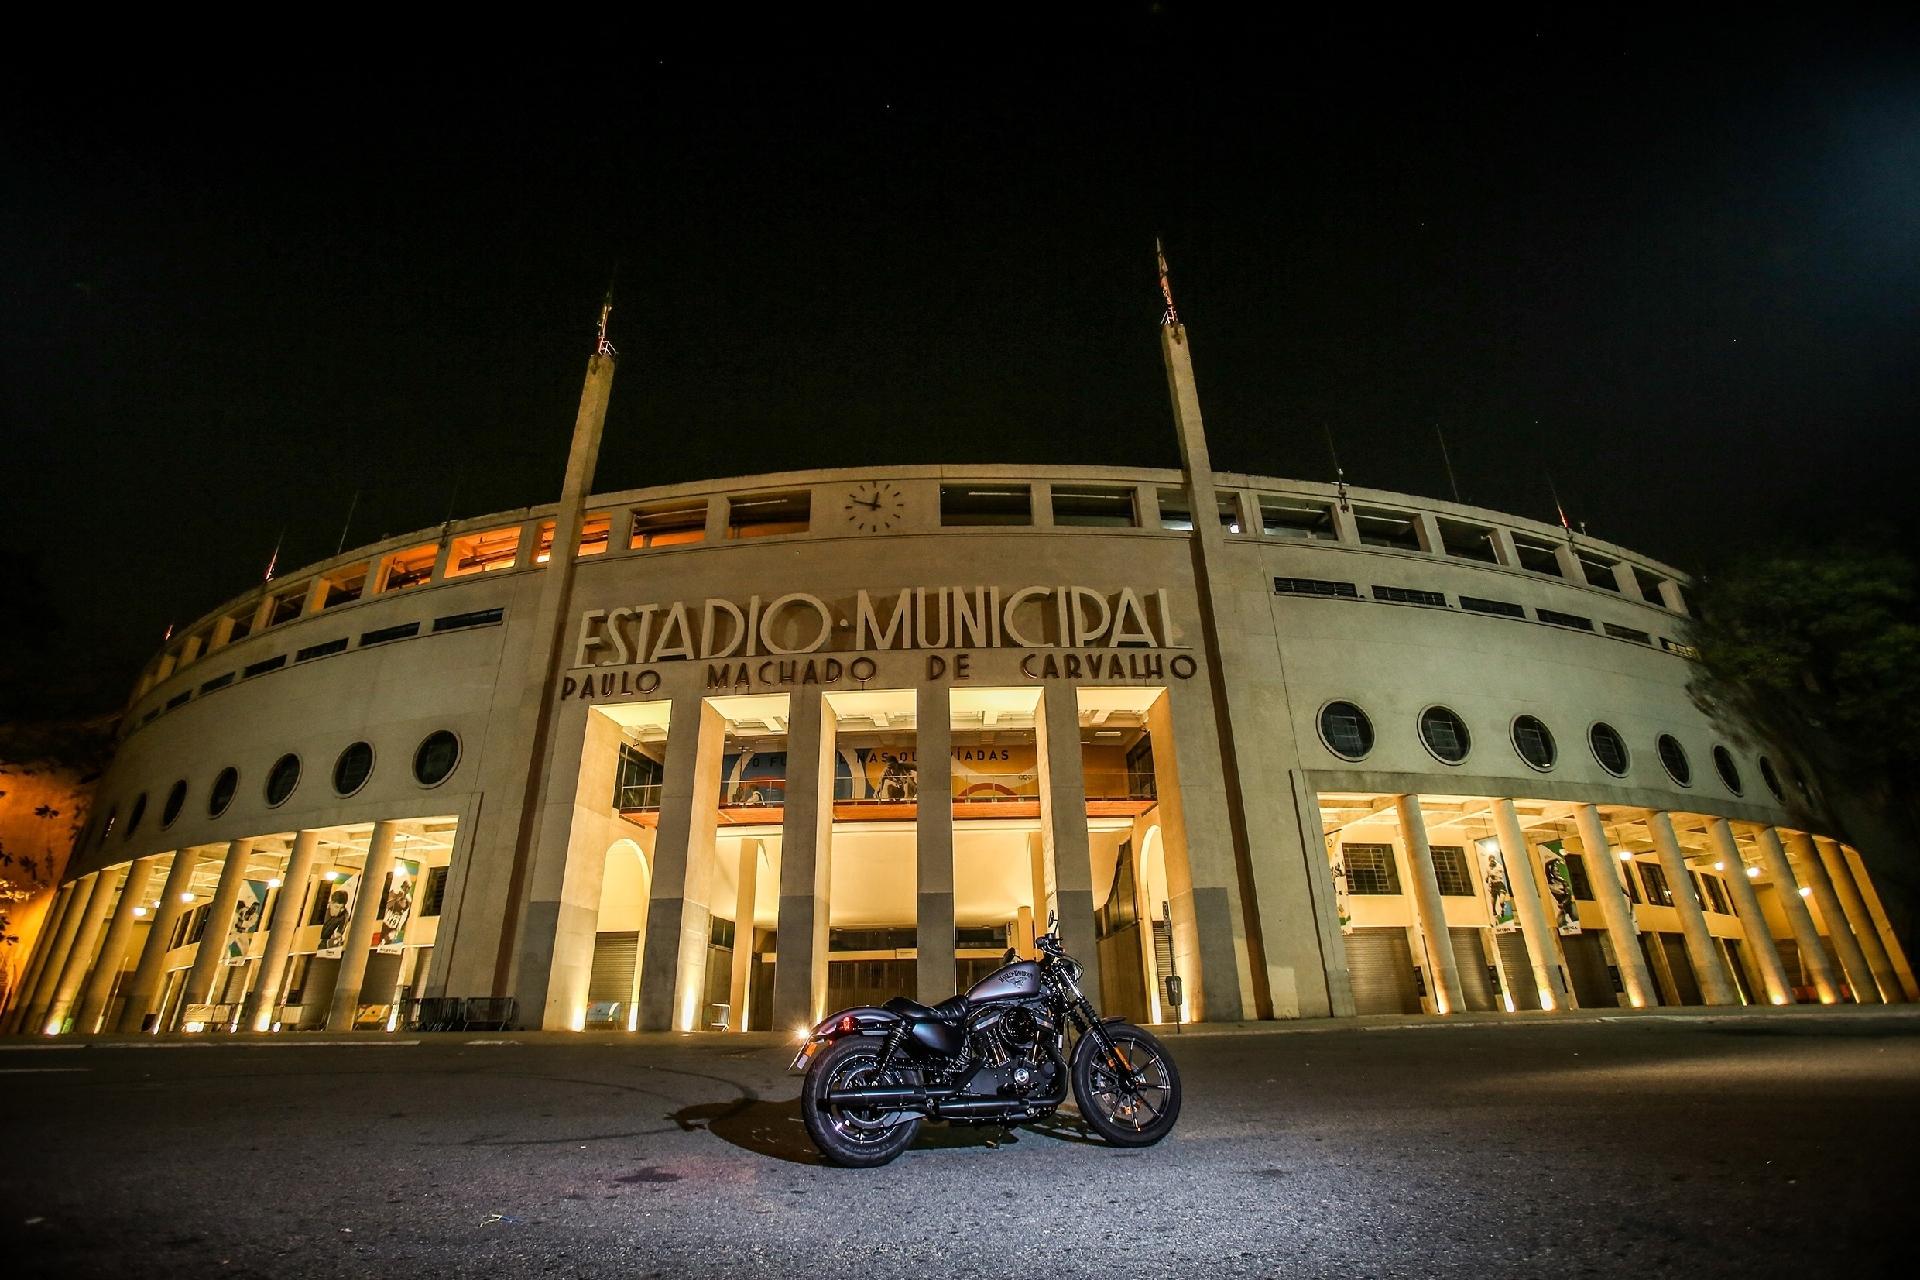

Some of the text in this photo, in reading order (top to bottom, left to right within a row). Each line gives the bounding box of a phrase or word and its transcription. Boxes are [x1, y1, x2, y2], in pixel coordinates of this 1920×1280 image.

[573, 586, 1193, 669] ESTADIO MUNICIPAL
[561, 653, 1198, 700] PAULO MACHADO DE CARVALHO
